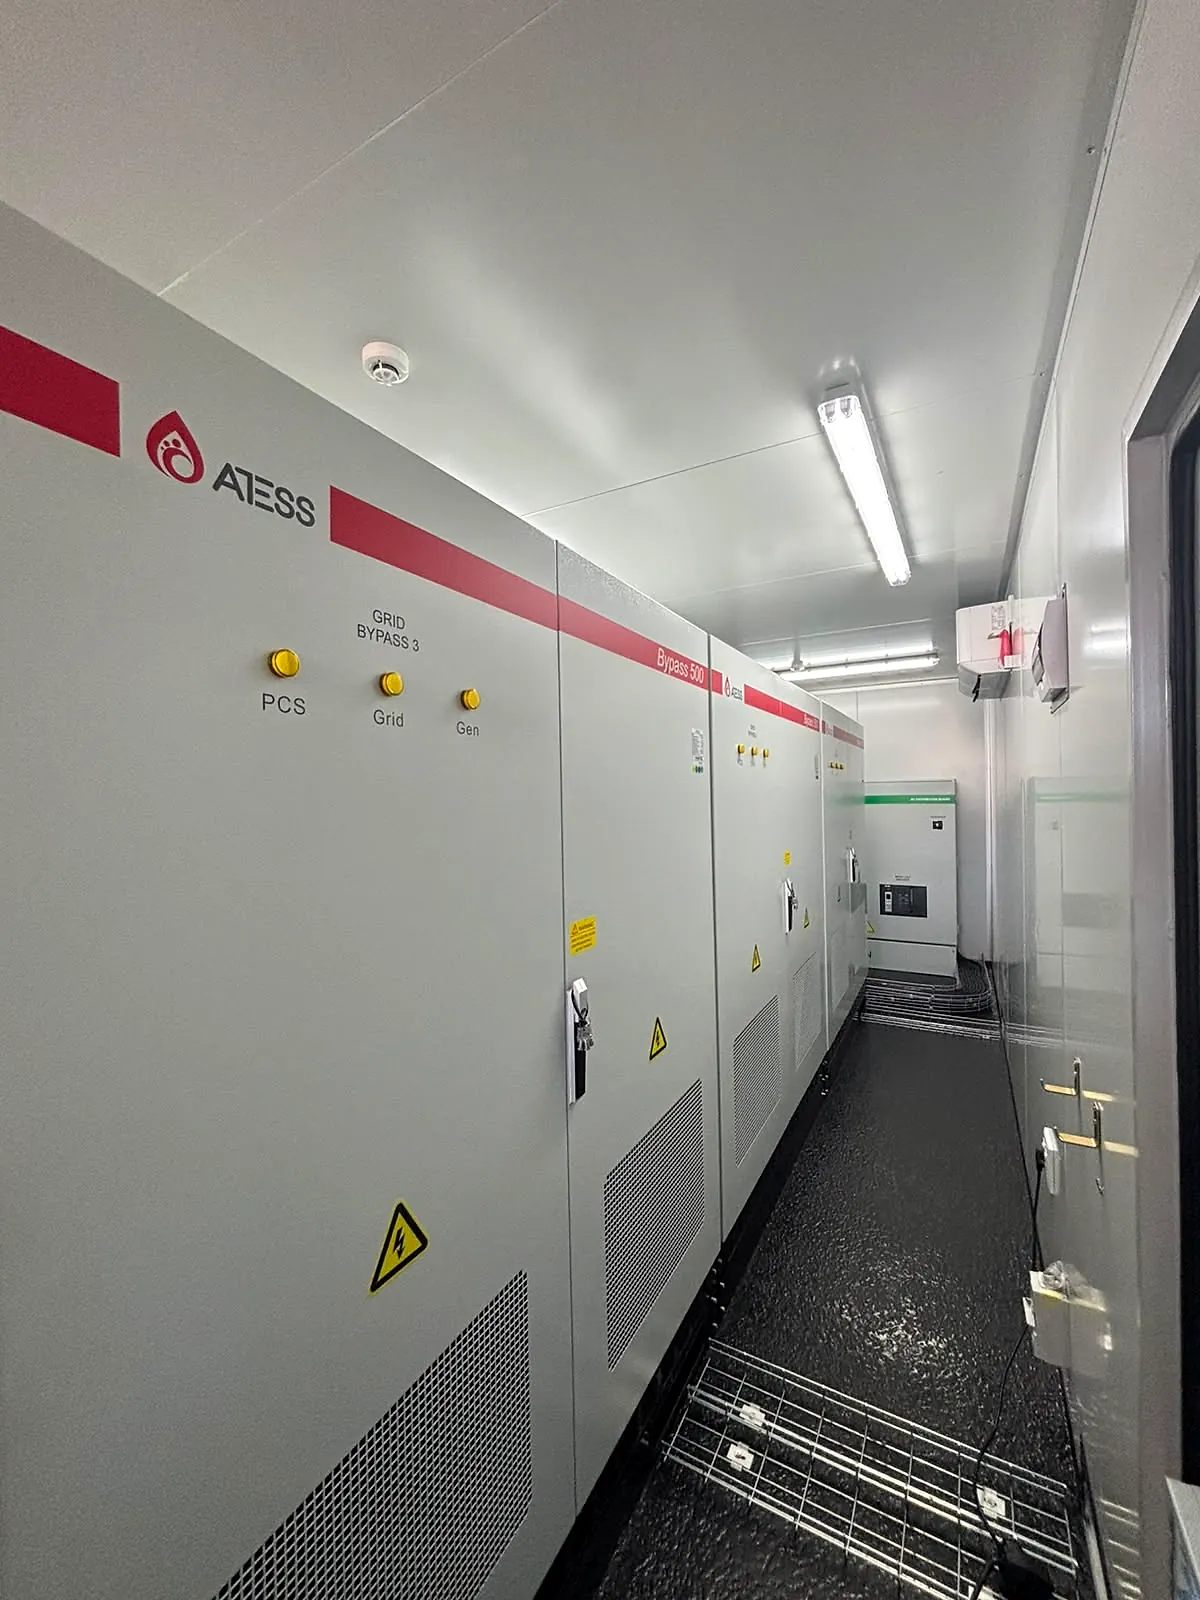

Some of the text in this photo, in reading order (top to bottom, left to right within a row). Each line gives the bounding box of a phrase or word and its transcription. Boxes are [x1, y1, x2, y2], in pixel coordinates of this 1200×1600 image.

[212, 462, 316, 527] ATESS
[372, 609, 405, 630] GRID
[357, 623, 420, 652] BYPASS 3
[657, 647, 704, 684] Bypass 500
[262, 692, 306, 715] PCS
[373, 709, 404, 728] Grid
[456, 721, 480, 737] Gen
